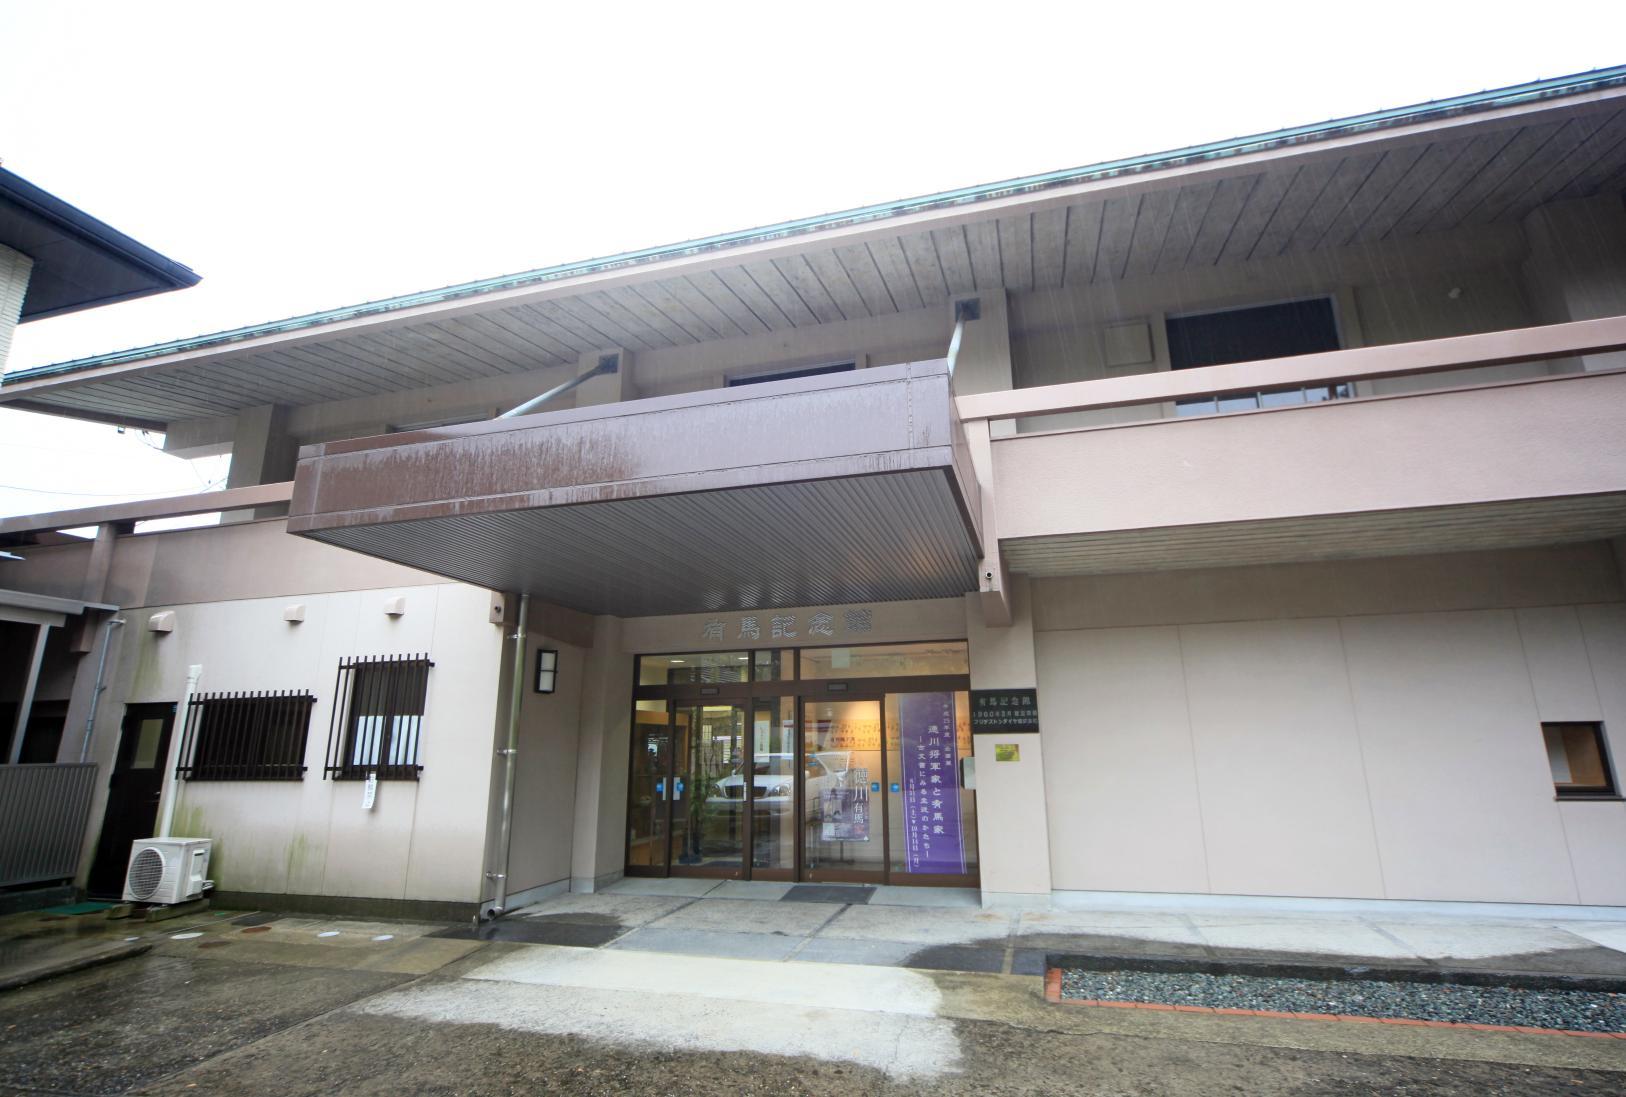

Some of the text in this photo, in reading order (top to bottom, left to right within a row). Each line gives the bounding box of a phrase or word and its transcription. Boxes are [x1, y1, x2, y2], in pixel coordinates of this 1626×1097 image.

[703, 608, 873, 641] 有馬記念館
[979, 696, 1031, 706] 有馬記念館
[928, 725, 945, 834] 徳川将軍家と有馬家
